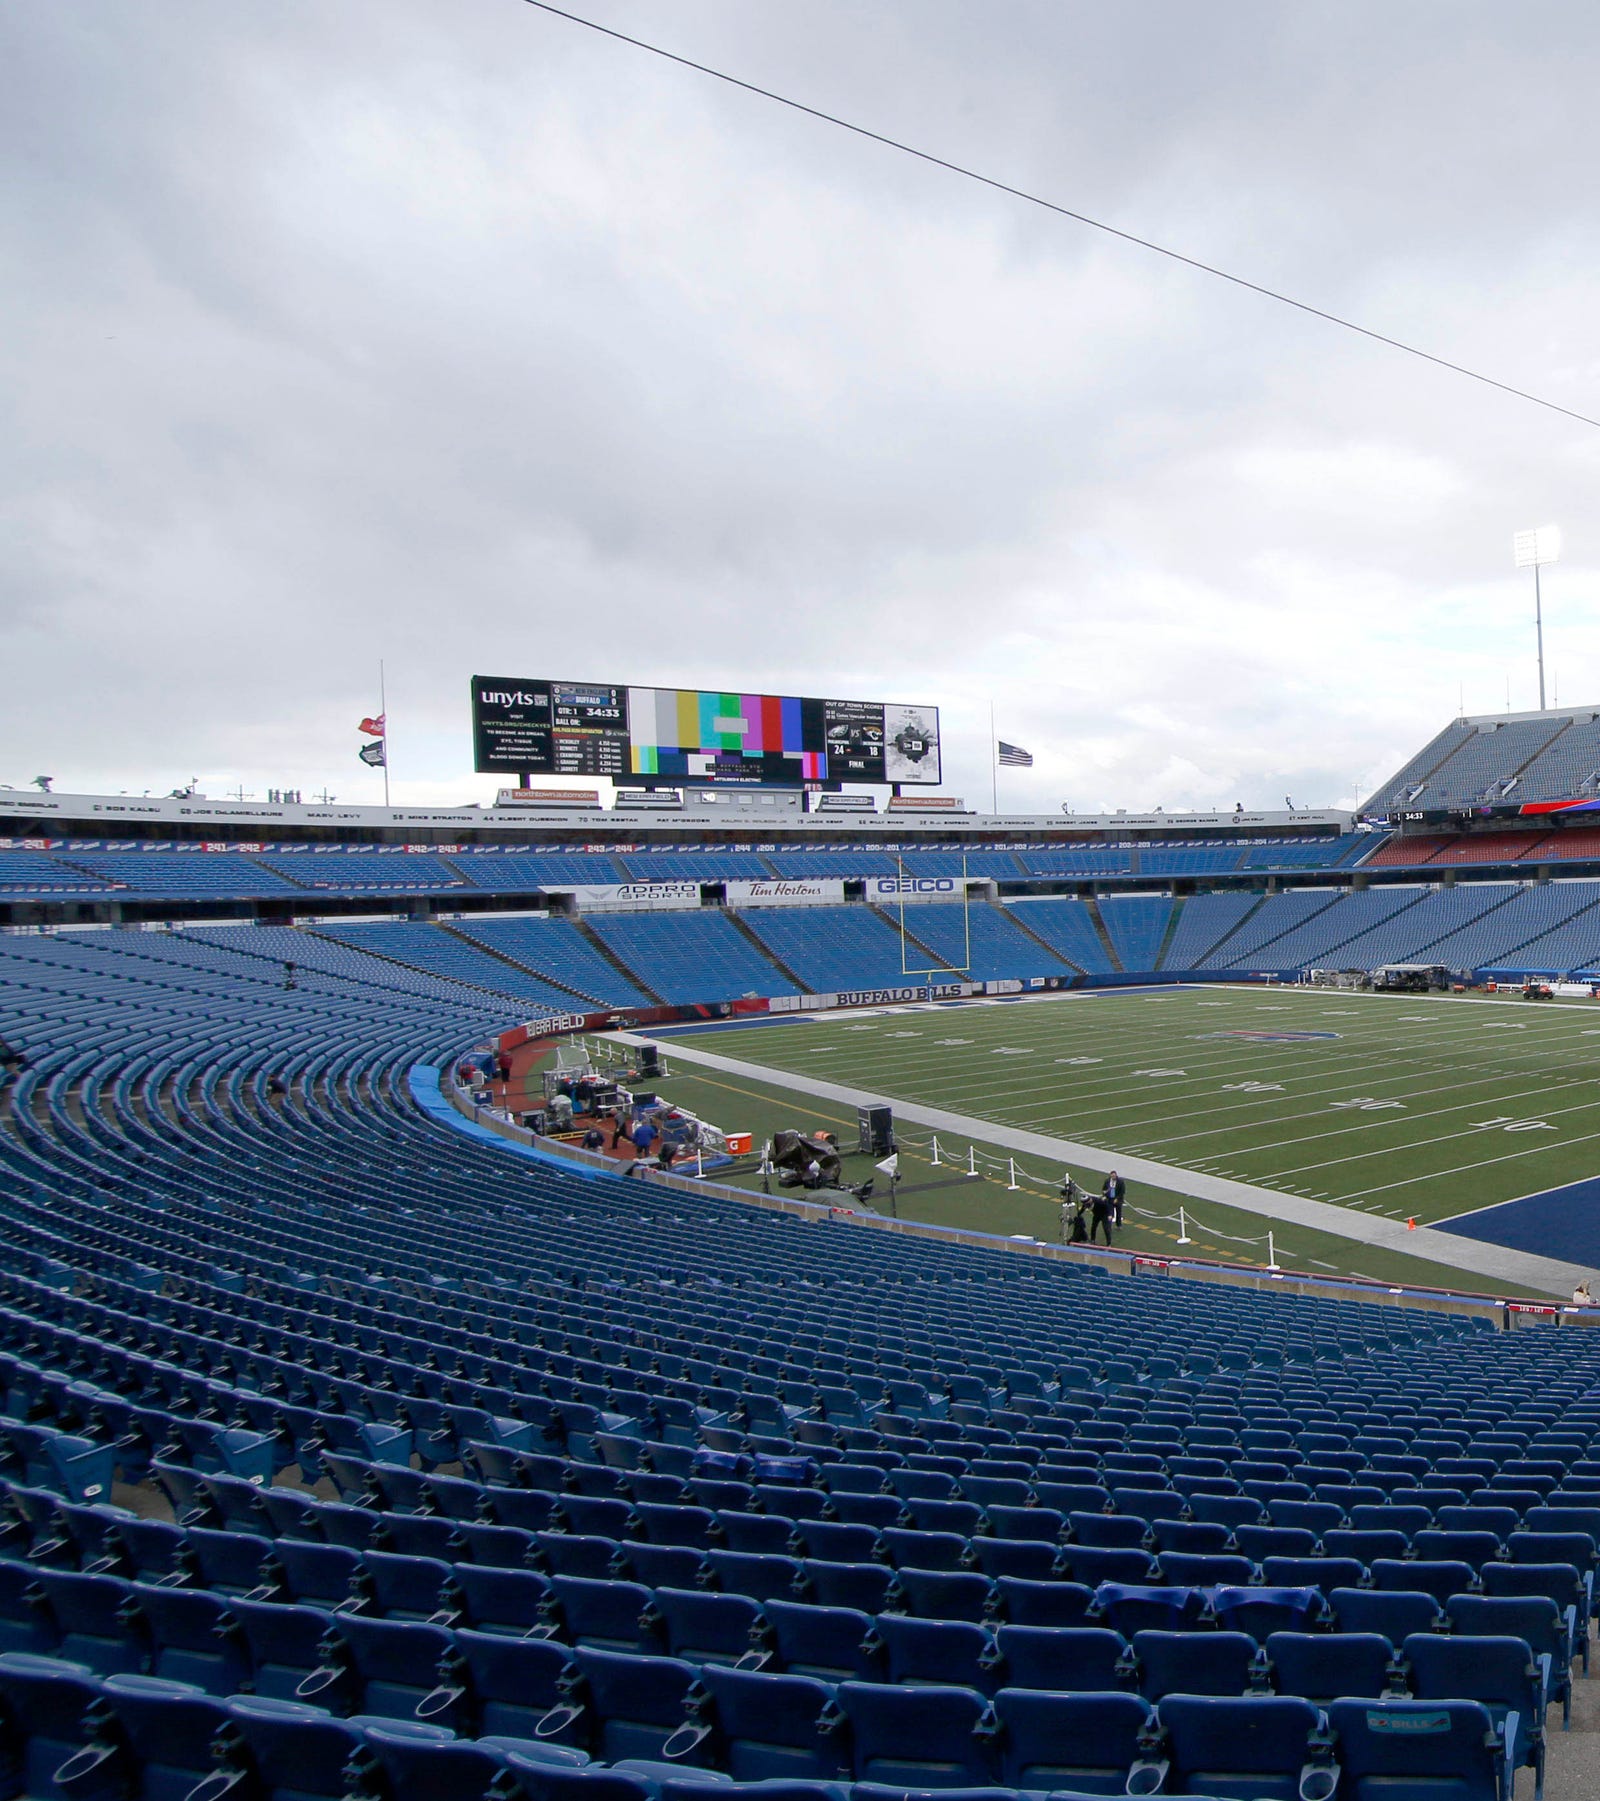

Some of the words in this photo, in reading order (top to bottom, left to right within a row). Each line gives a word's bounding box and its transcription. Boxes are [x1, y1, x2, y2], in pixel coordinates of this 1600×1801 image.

[482, 691, 534, 708] unyts
[575, 696, 600, 705] BUFFALO
[586, 707, 620, 718] 34:33
[850, 729, 860, 738] VS
[834, 745, 844, 755] 24
[869, 746, 878, 756] 18
[848, 761, 865, 769] FINAL
[1404, 812, 1424, 820] 34:33
[24, 840, 46, 849] 241
[206, 843, 227, 852] 241
[239, 843, 260, 852] 242
[408, 845, 428, 853] 242
[438, 845, 458, 853] 243
[587, 845, 605, 853] 243
[615, 845, 633, 853] 244
[735, 844, 751, 852] 244
[759, 844, 776, 852] 200
[749, 883, 772, 896] Tim
[774, 882, 821, 896] Hortons
[878, 879, 954, 893] GEICO
[617, 885, 696, 897] ADPRO
[622, 892, 696, 900] SPORTS
[836, 988, 913, 1006] BUFFALO
[536, 1019, 552, 1034] ERA
[552, 1015, 585, 1031] FIELD
[1469, 1116, 1548, 1132] 10
[730, 1140, 739, 1150] G
